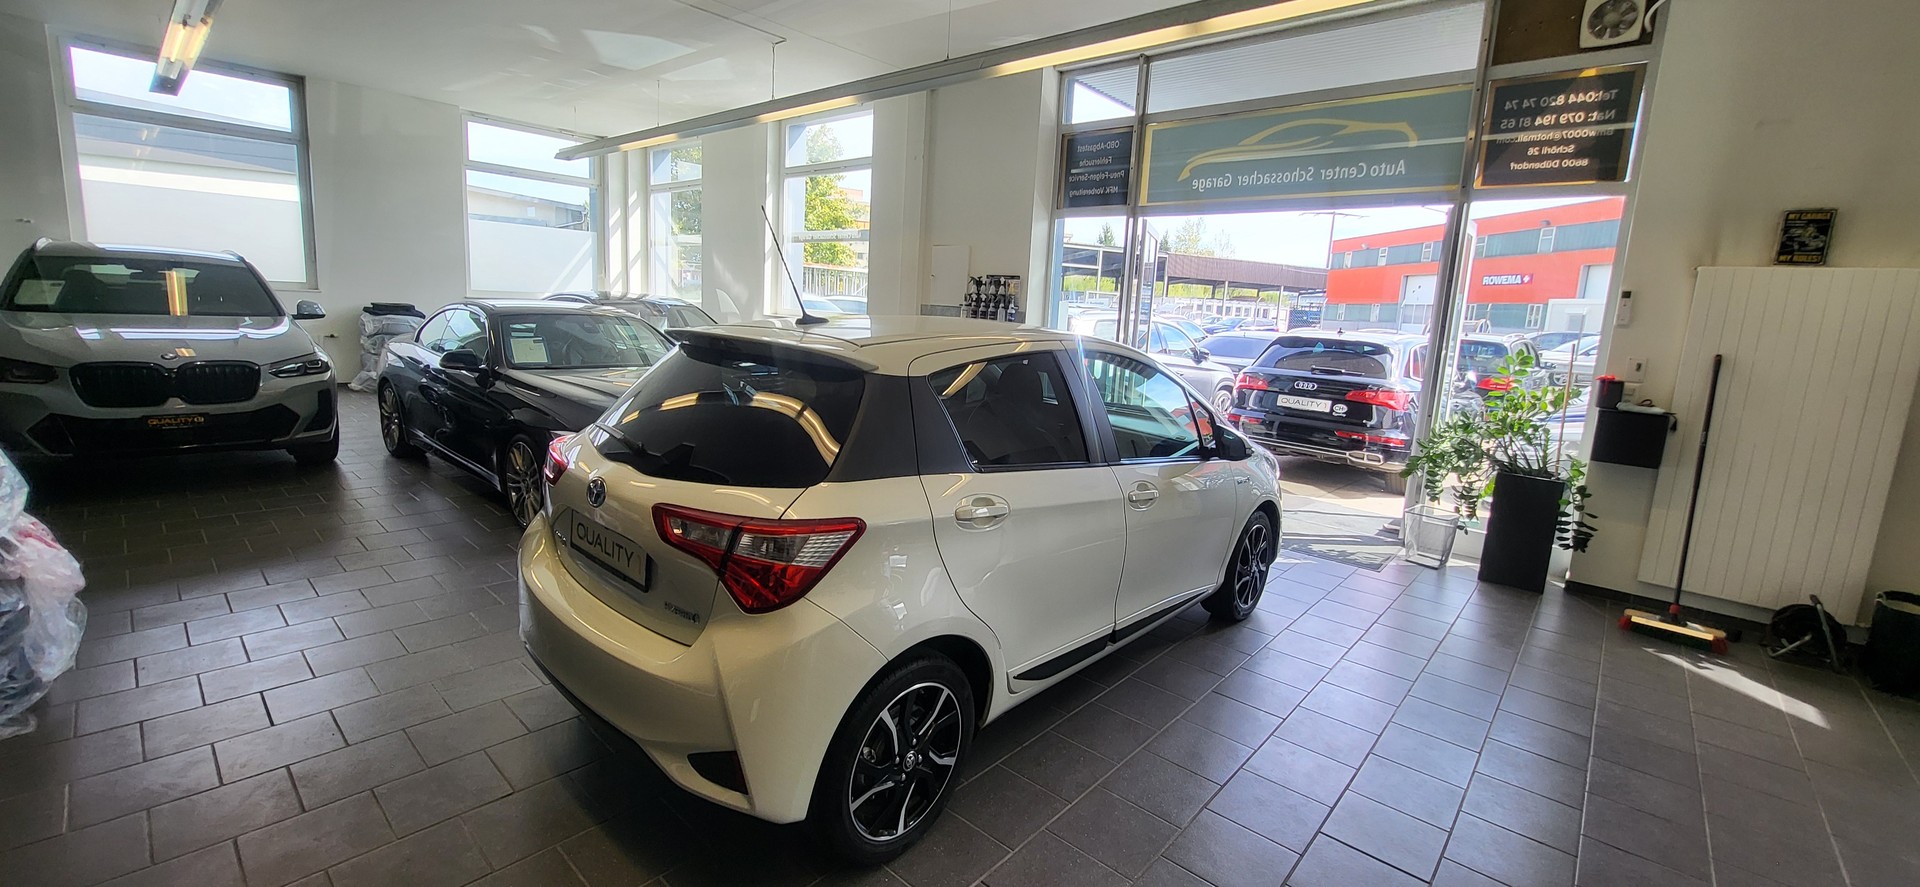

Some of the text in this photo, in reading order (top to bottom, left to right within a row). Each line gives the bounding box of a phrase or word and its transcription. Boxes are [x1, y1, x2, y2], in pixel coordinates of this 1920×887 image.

[1482, 275, 1522, 285] ROWEMA
[1280, 397, 1322, 408] QUALITY
[148, 417, 194, 425] QUALITY
[576, 522, 635, 568] QUALITY
